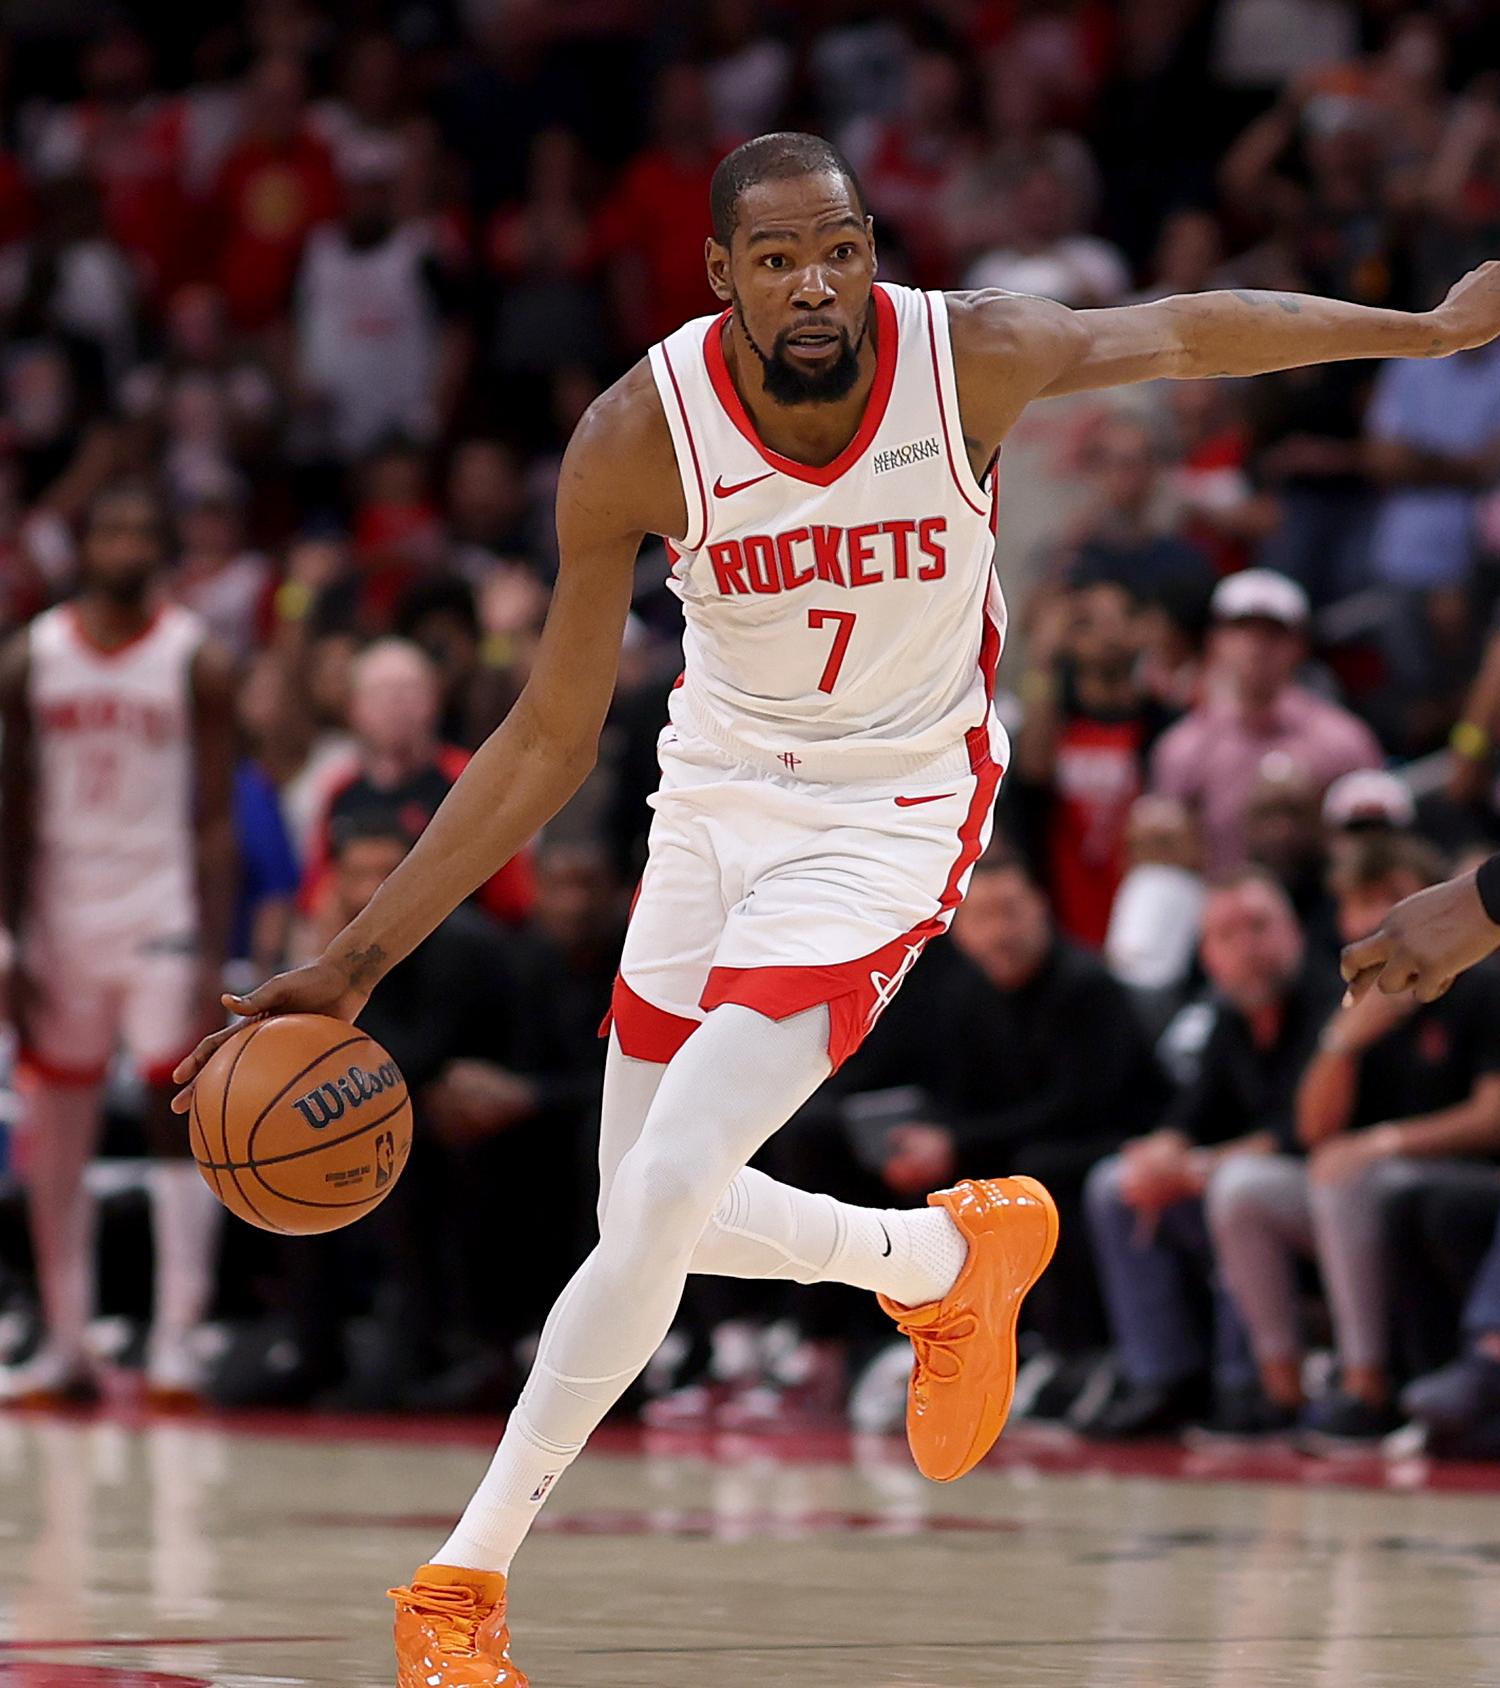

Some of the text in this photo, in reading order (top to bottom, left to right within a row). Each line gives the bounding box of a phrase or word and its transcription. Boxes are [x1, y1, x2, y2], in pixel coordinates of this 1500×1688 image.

[873, 437, 939, 465] MEMORIAL
[874, 446, 940, 474] HERMANN
[707, 516, 948, 596] ROCKETS
[807, 608, 857, 695] 7
[292, 1062, 402, 1130] Wilson
